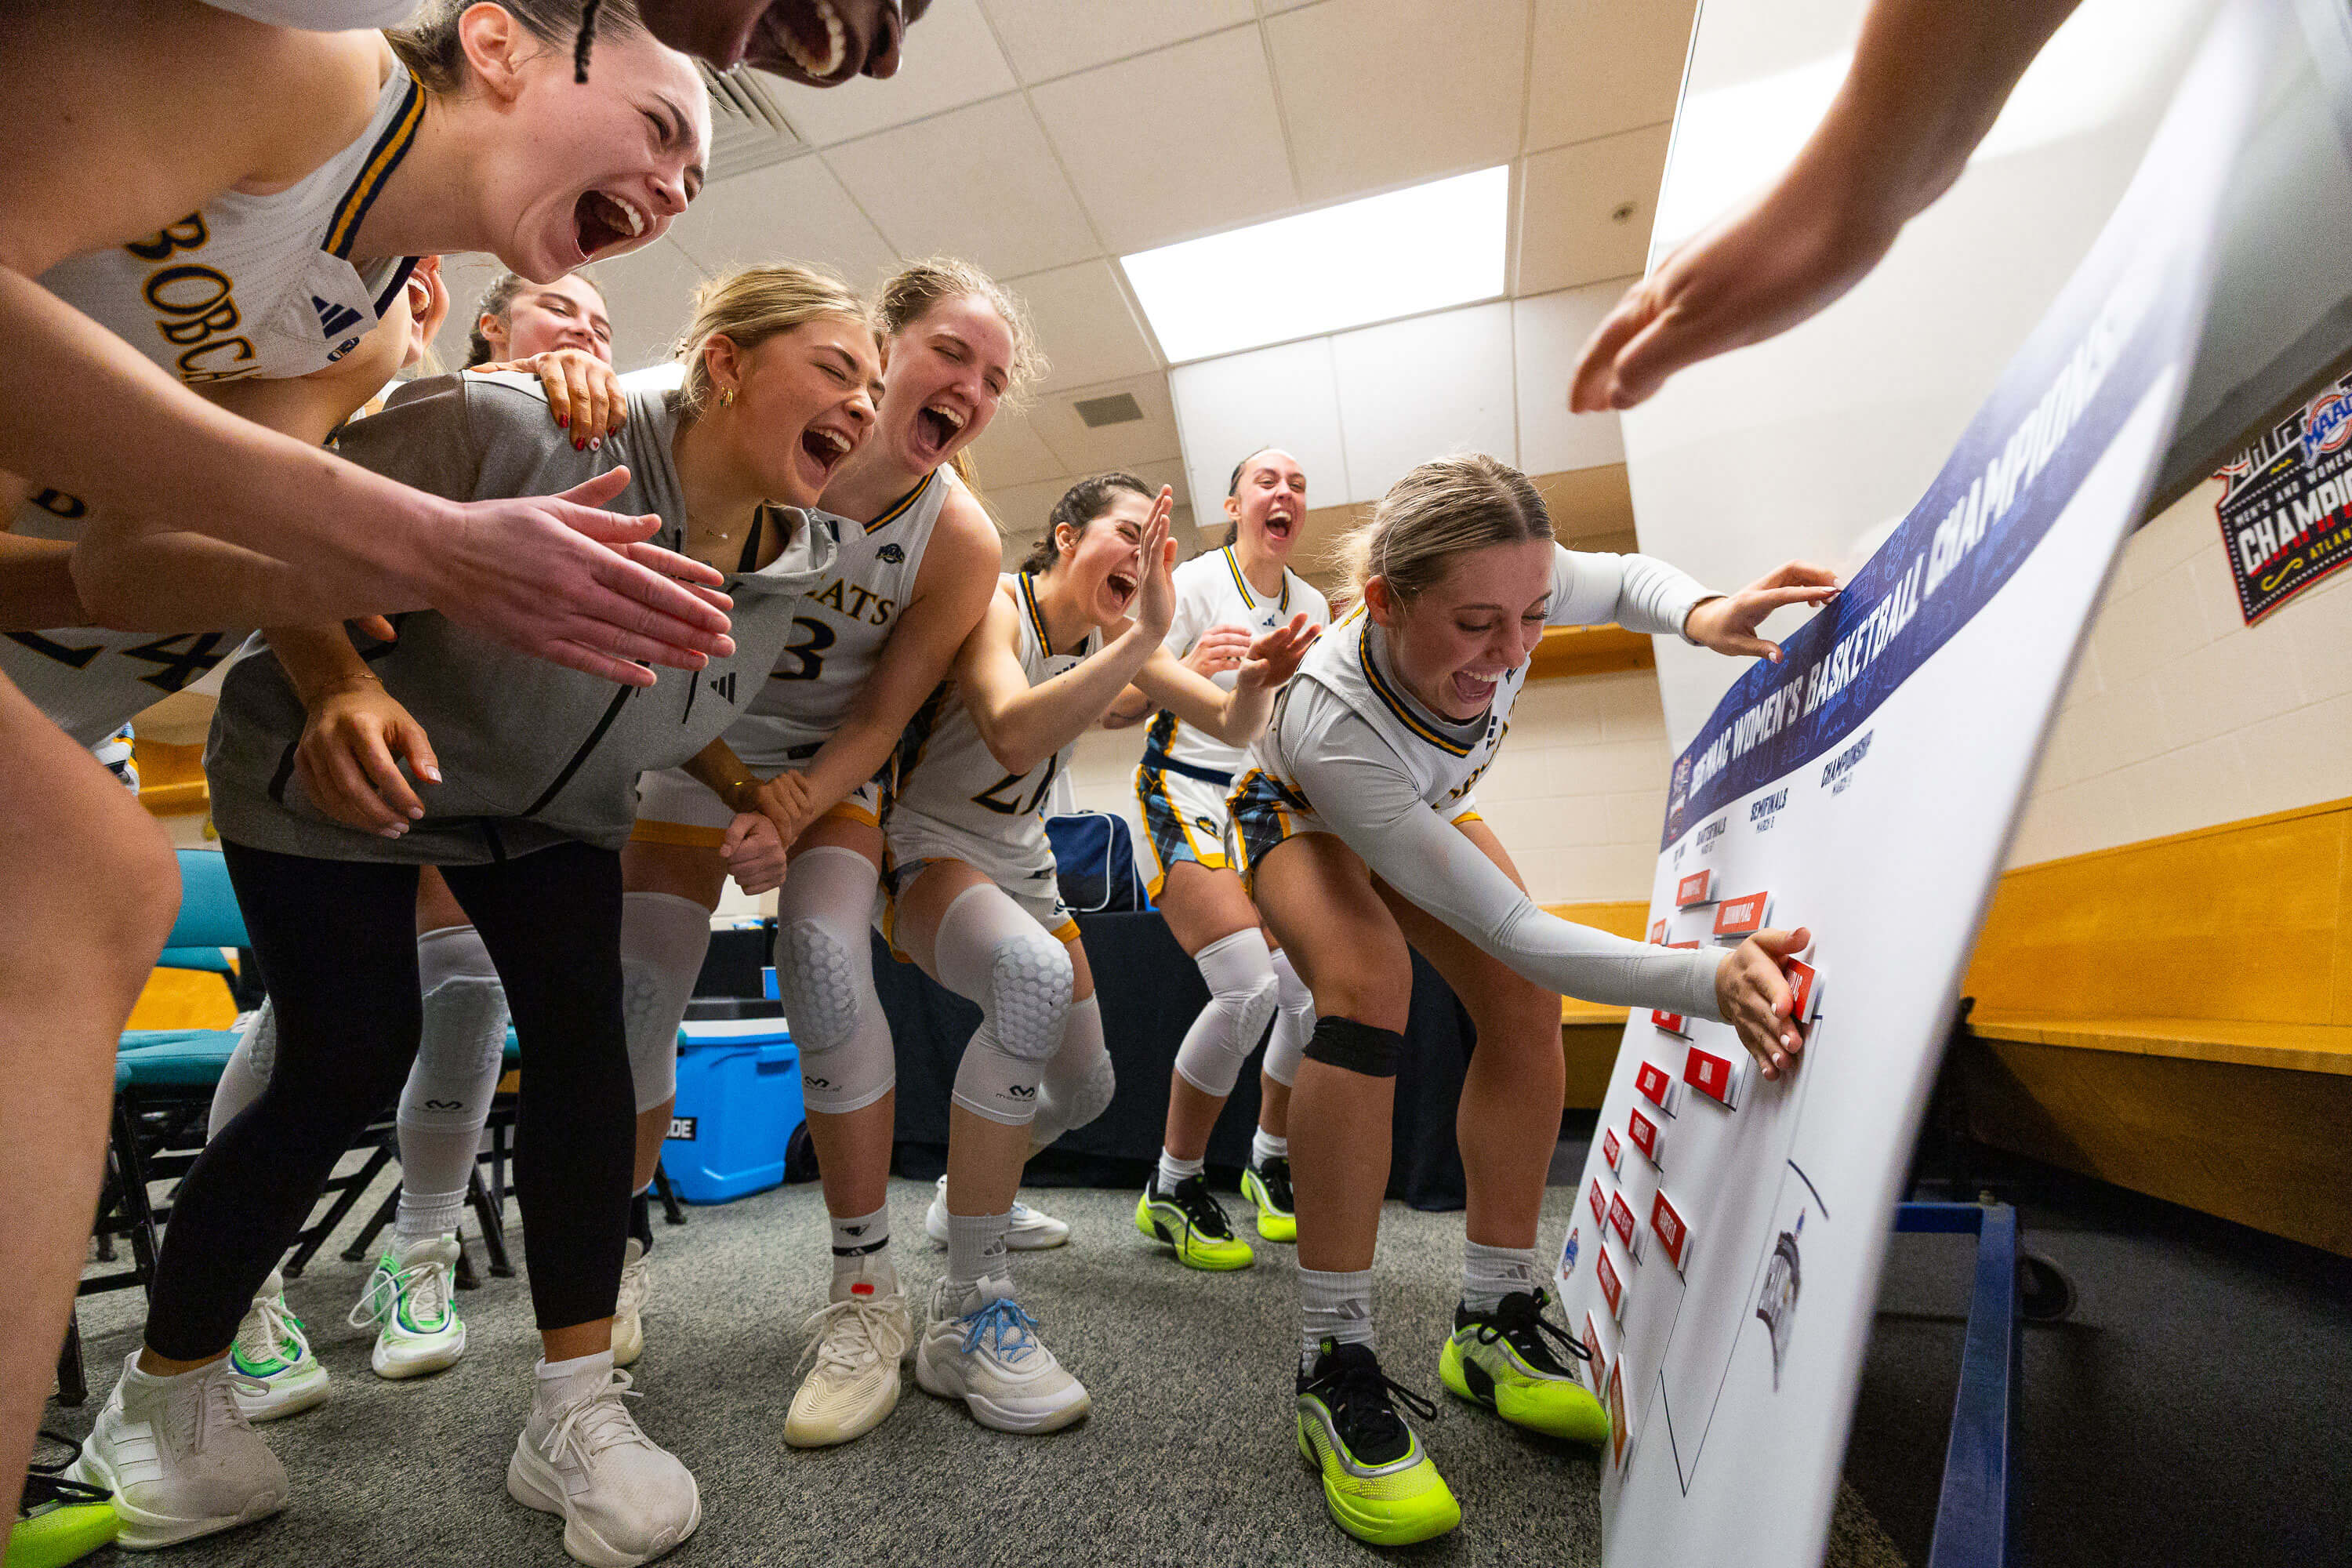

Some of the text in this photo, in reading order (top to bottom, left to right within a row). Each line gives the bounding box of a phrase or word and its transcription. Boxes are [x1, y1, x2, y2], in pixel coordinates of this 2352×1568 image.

[2235, 499, 2270, 527] MEN'S
[2275, 481, 2301, 503] AND
[2309, 524, 2352, 558] ATLAN
[803, 573, 895, 626] ATS
[1732, 674, 1804, 762] WOMEN'S
[1802, 551, 1925, 719] BASKETBALL
[1750, 787, 1788, 822] SEMIFINALS
[667, 1119, 691, 1138] DE
